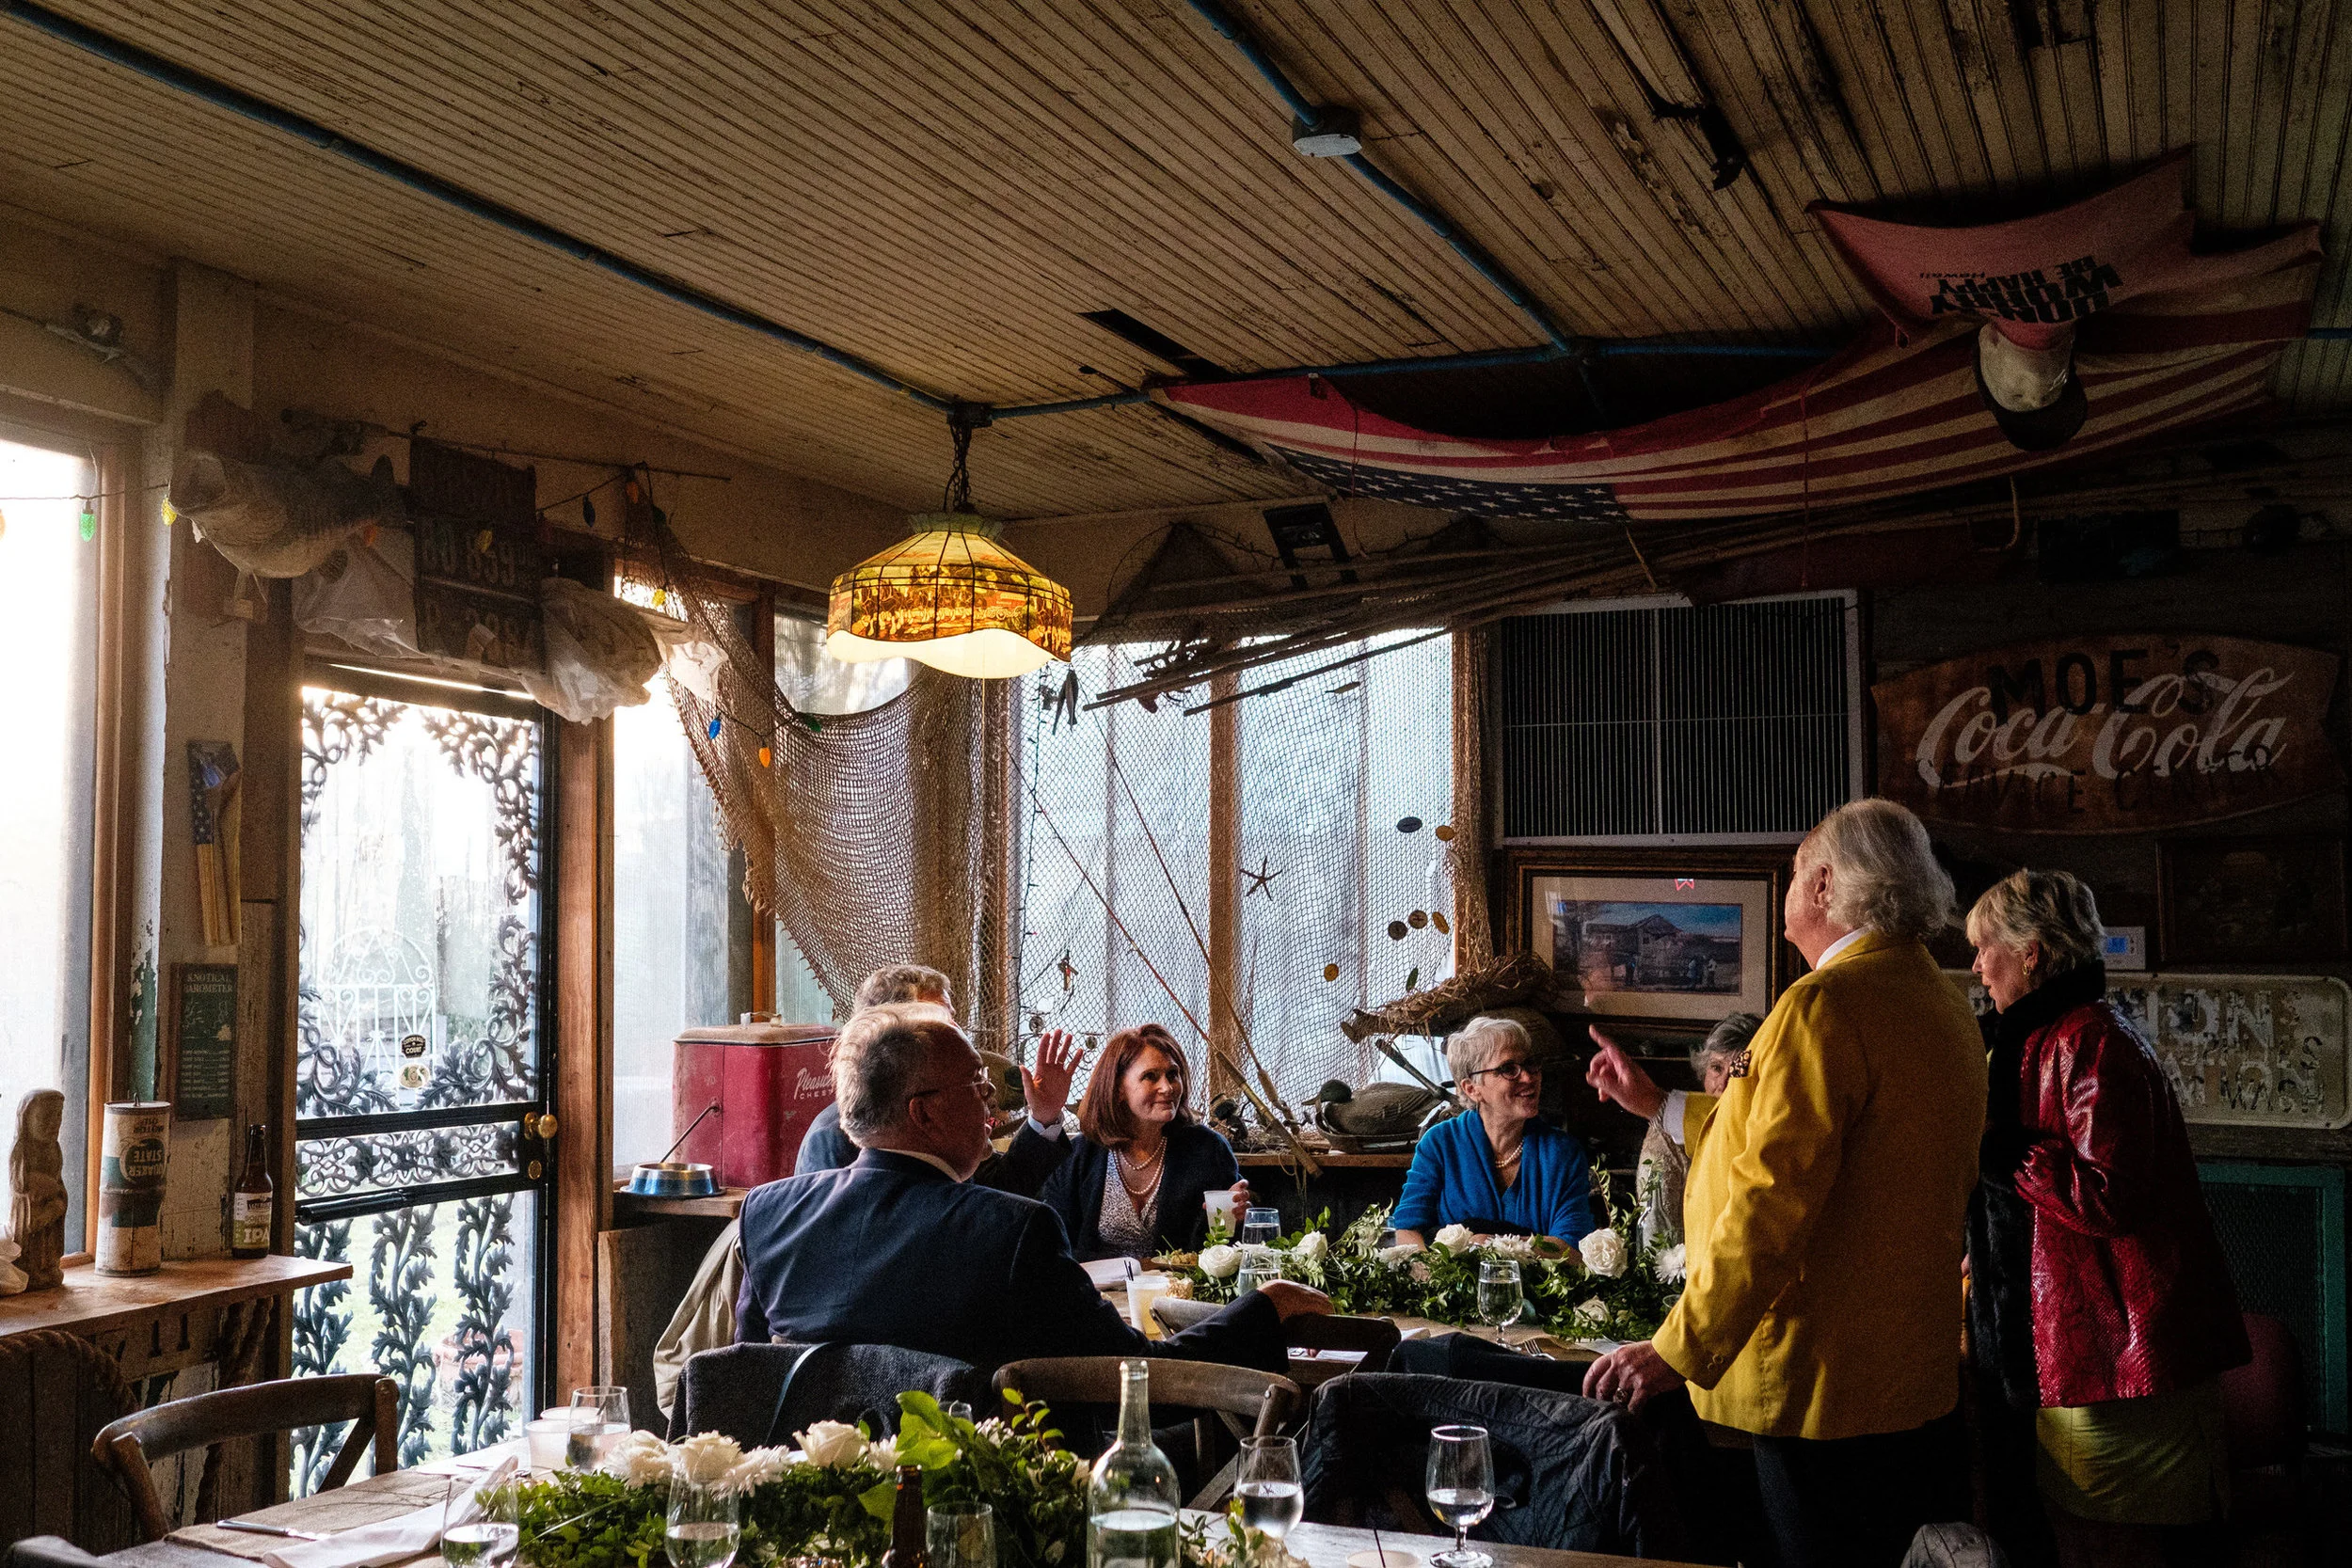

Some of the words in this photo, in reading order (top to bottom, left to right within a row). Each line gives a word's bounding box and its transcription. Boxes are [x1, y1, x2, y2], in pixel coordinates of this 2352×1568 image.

[1938, 270, 2046, 294] HAPPY
[1986, 641, 2219, 726] MOE'S
[133, 1149, 163, 1164] STATE
[244, 1226, 270, 1243] IPA
